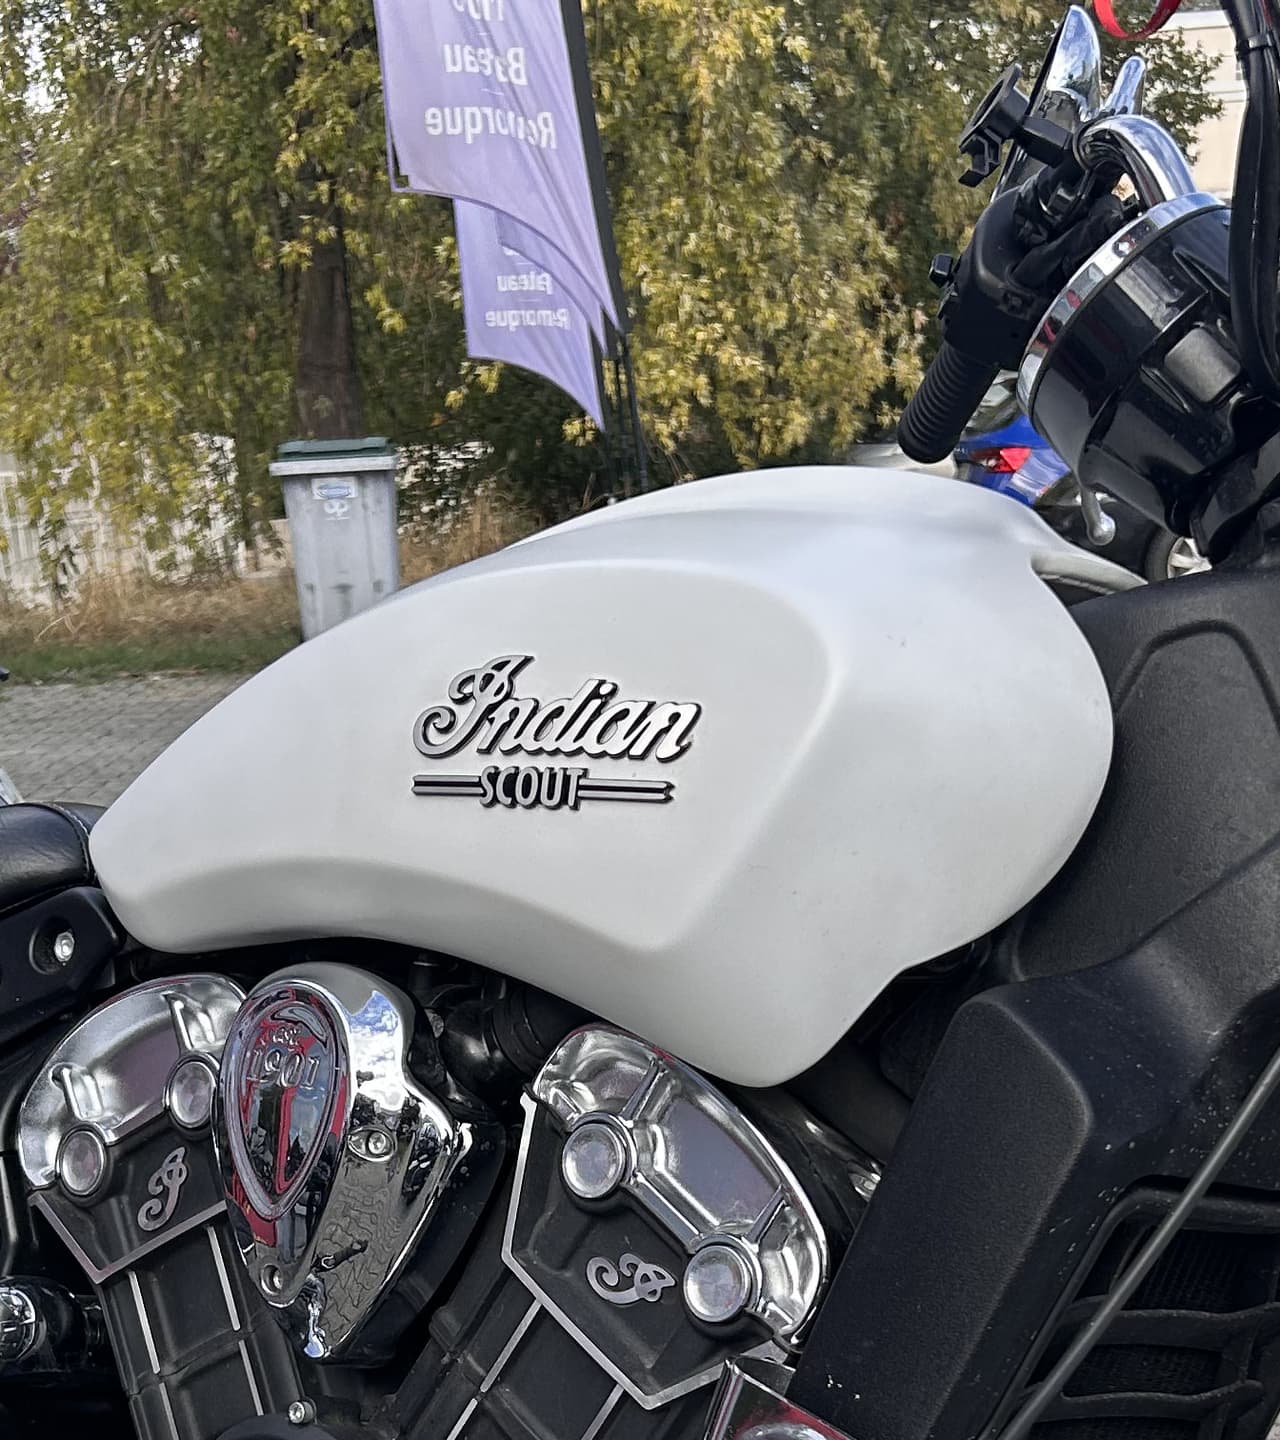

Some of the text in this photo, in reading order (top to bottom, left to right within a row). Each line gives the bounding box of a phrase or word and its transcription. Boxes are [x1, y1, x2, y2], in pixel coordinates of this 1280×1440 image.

[412, 654, 703, 763] Indian
[480, 765, 589, 811] SCOUT
[247, 1047, 320, 1090] 1901
